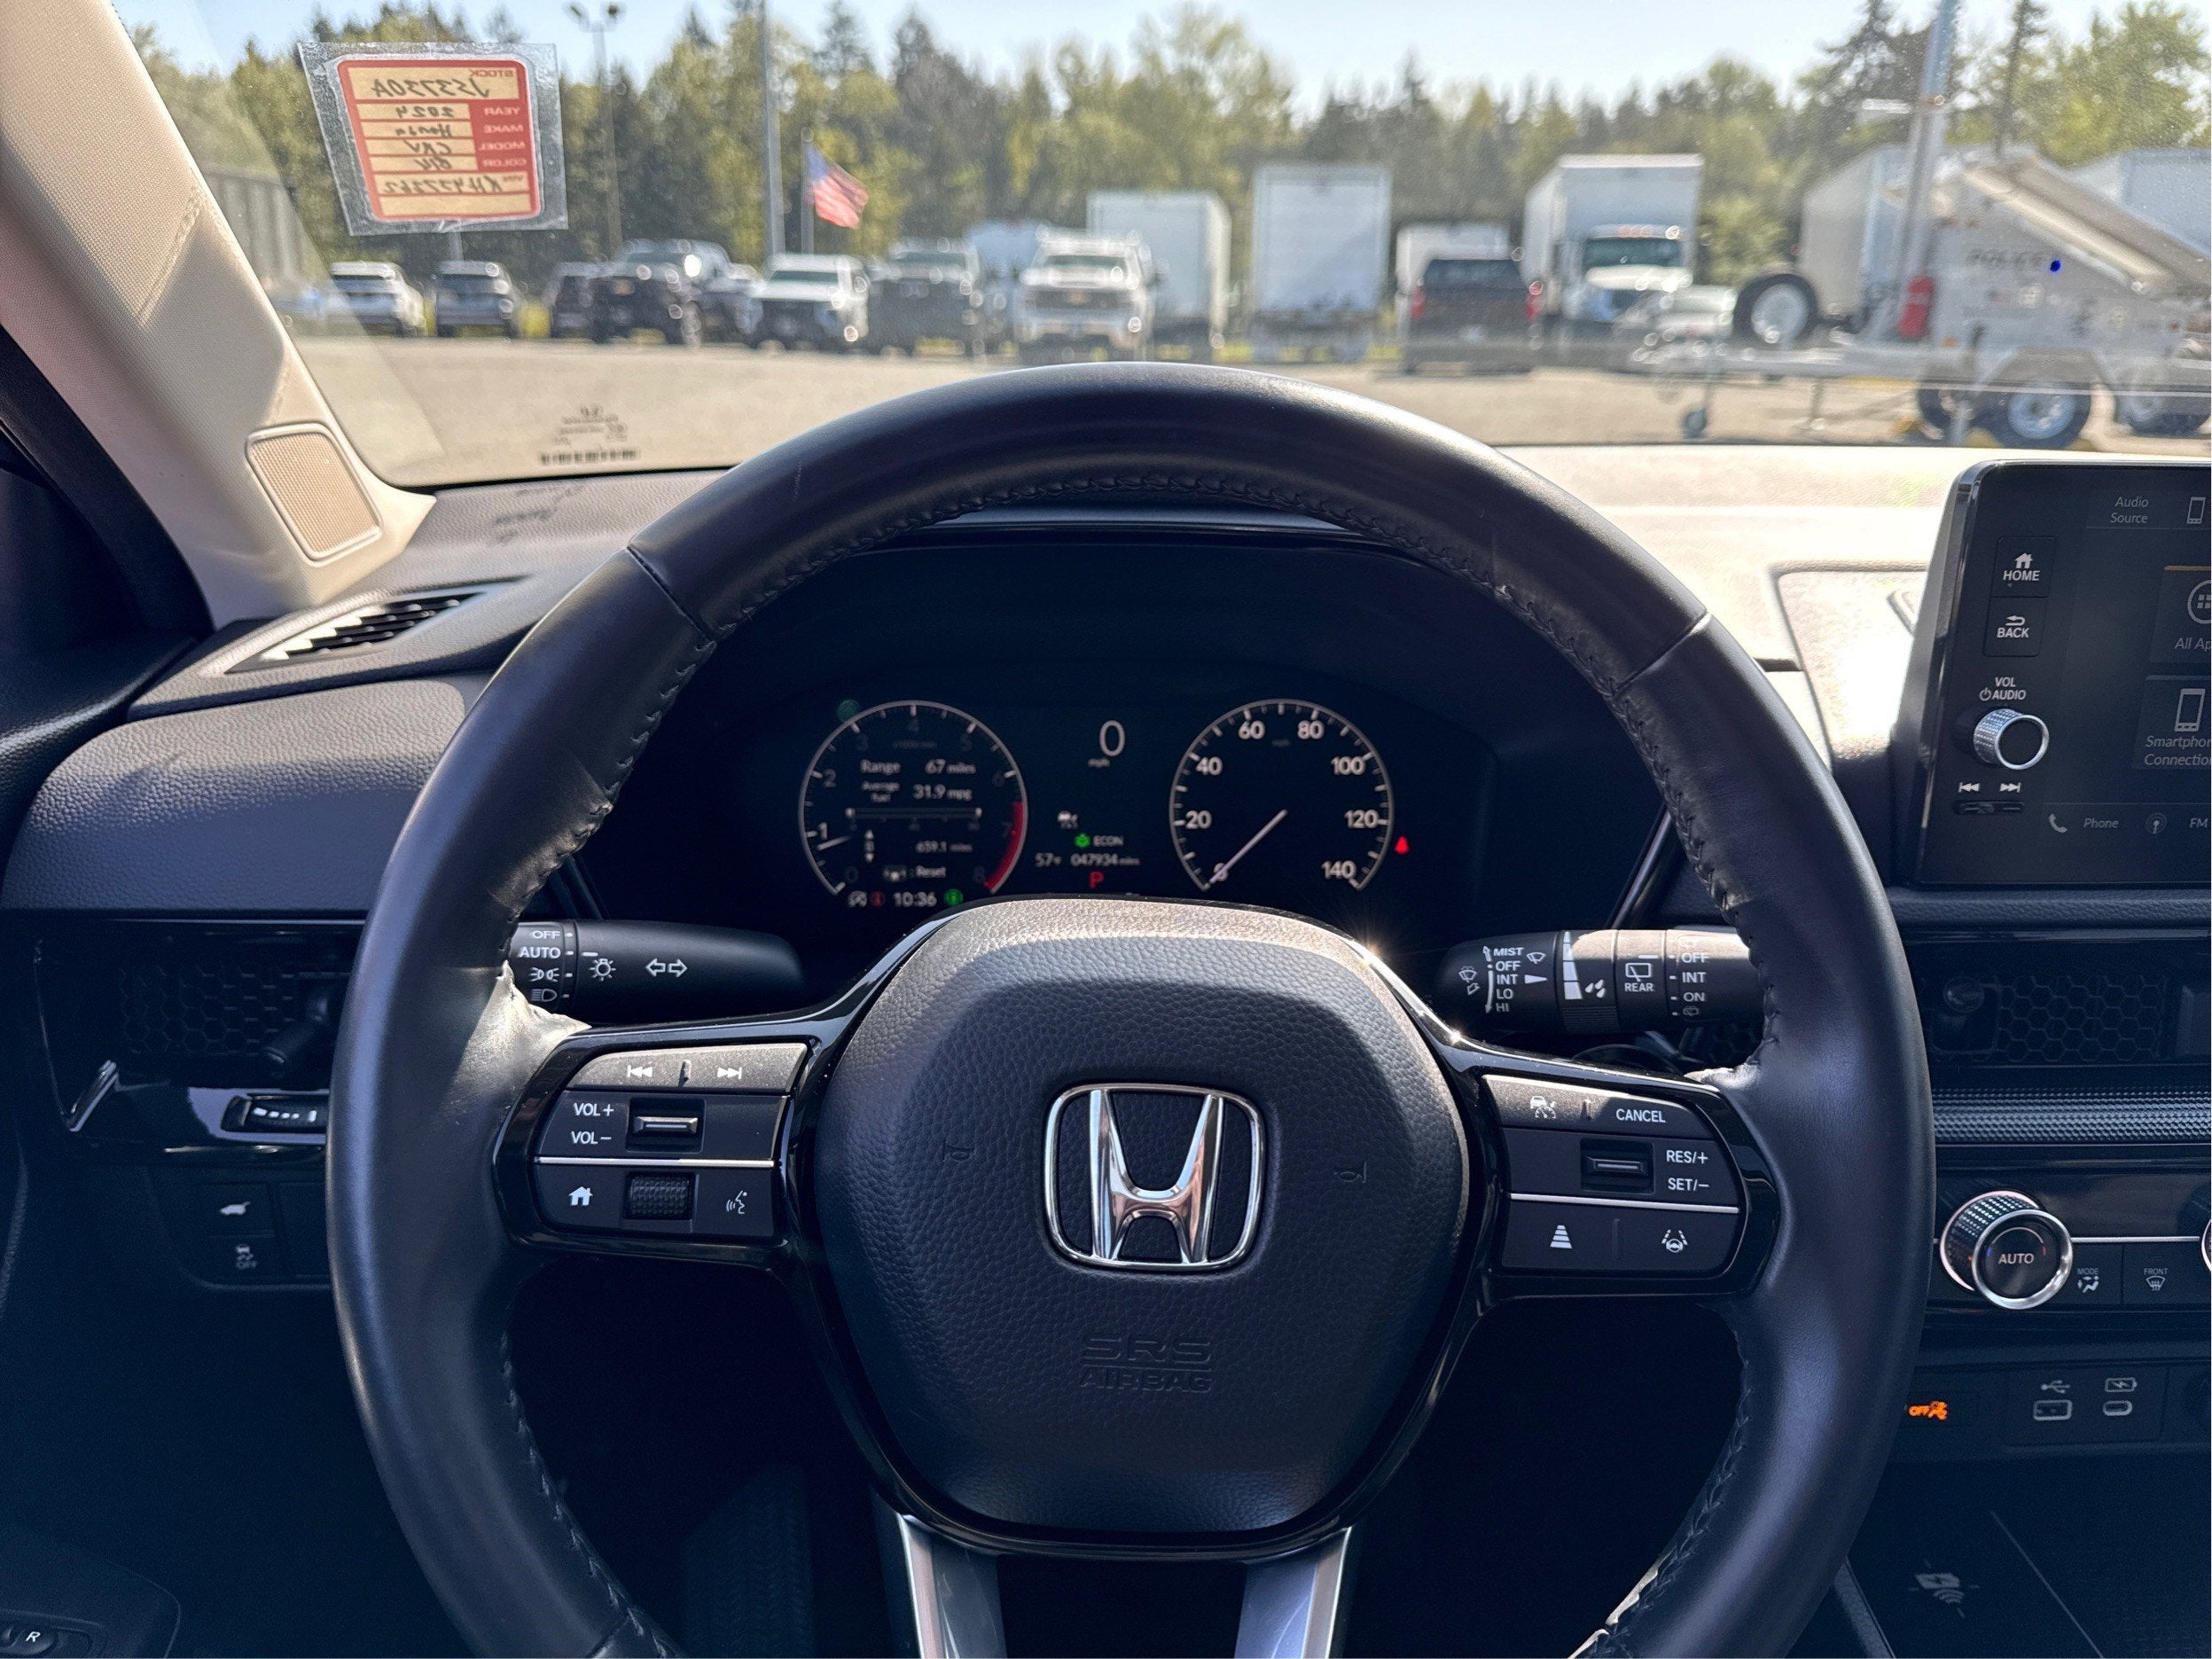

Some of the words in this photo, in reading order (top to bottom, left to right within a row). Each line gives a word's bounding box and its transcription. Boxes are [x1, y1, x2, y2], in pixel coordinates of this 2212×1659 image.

[2114, 497, 2149, 507] Audio
[2110, 513, 2148, 523] Source
[2003, 570, 2040, 582] HOME
[1997, 628, 2030, 638] BACK
[2175, 637, 2192, 649] All
[1995, 677, 2017, 687] VOL
[1991, 690, 2027, 700] AUDIO
[1239, 721, 1265, 740] 60
[1297, 721, 1325, 740] 80
[1099, 720, 1126, 756] 0
[2144, 753, 2211, 766] Connectio
[860, 759, 901, 775] Range
[925, 759, 946, 774] 67
[1196, 756, 1223, 776] 40
[1331, 756, 1365, 776] 100
[1185, 810, 1212, 829] 20
[1344, 810, 1379, 829] 120
[2083, 818, 2119, 829] Phone
[2189, 818, 2208, 828] FM
[1093, 835, 1124, 847] ECON
[1321, 860, 1356, 880] 140
[1090, 872, 1105, 888] P
[893, 891, 937, 907] 10:36
[532, 930, 560, 940] OFF
[518, 947, 561, 959] AUTO
[1493, 947, 1524, 957] MIST
[1681, 952, 1708, 964] OFF
[1495, 960, 1520, 972] OFF
[1497, 974, 1519, 985] INT
[1681, 972, 1706, 983] INT
[1624, 982, 1654, 992] REAR
[1497, 989, 1513, 999] LO
[1683, 992, 1705, 1002] ON
[1496, 1003, 1510, 1013] HI
[574, 1103, 614, 1116] VOL+
[1616, 1108, 1666, 1123] CANCEL
[1666, 1150, 1708, 1164] RES/+
[1668, 1178, 1709, 1192] SET/-
[1998, 1253, 2035, 1264] AUTO
[1083, 1334, 1211, 1364] SRS
[1079, 1373, 1212, 1393] AIRBAG
[26, 1631, 41, 1642] R
